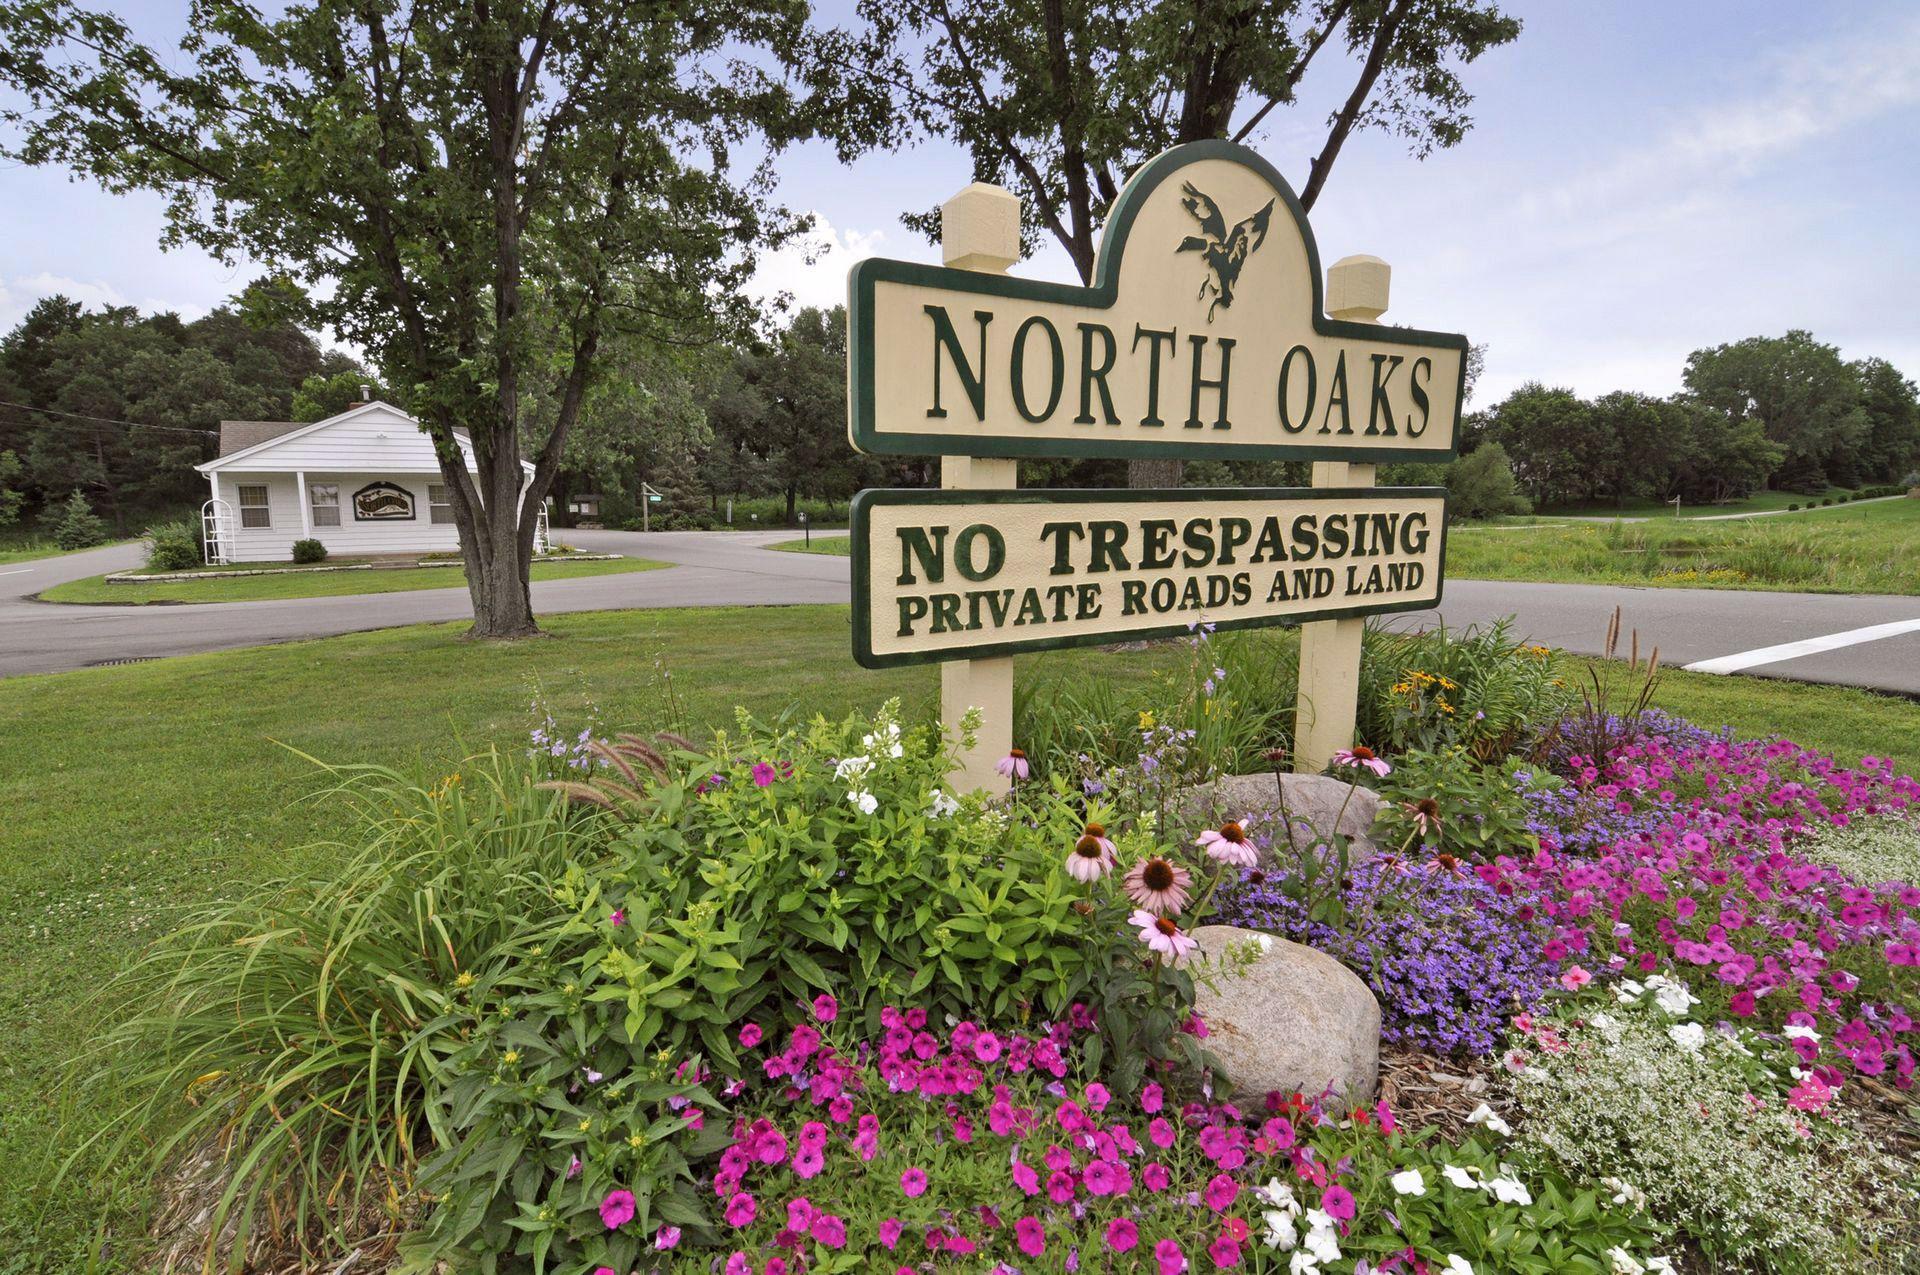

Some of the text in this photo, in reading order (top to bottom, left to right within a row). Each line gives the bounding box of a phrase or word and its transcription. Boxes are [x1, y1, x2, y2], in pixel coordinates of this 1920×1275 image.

[923, 304, 1433, 439] NORTH OAKS
[896, 512, 1430, 586] NO TRESPASSING
[896, 561, 1425, 638] PRIVATE ROADS AND LAND
